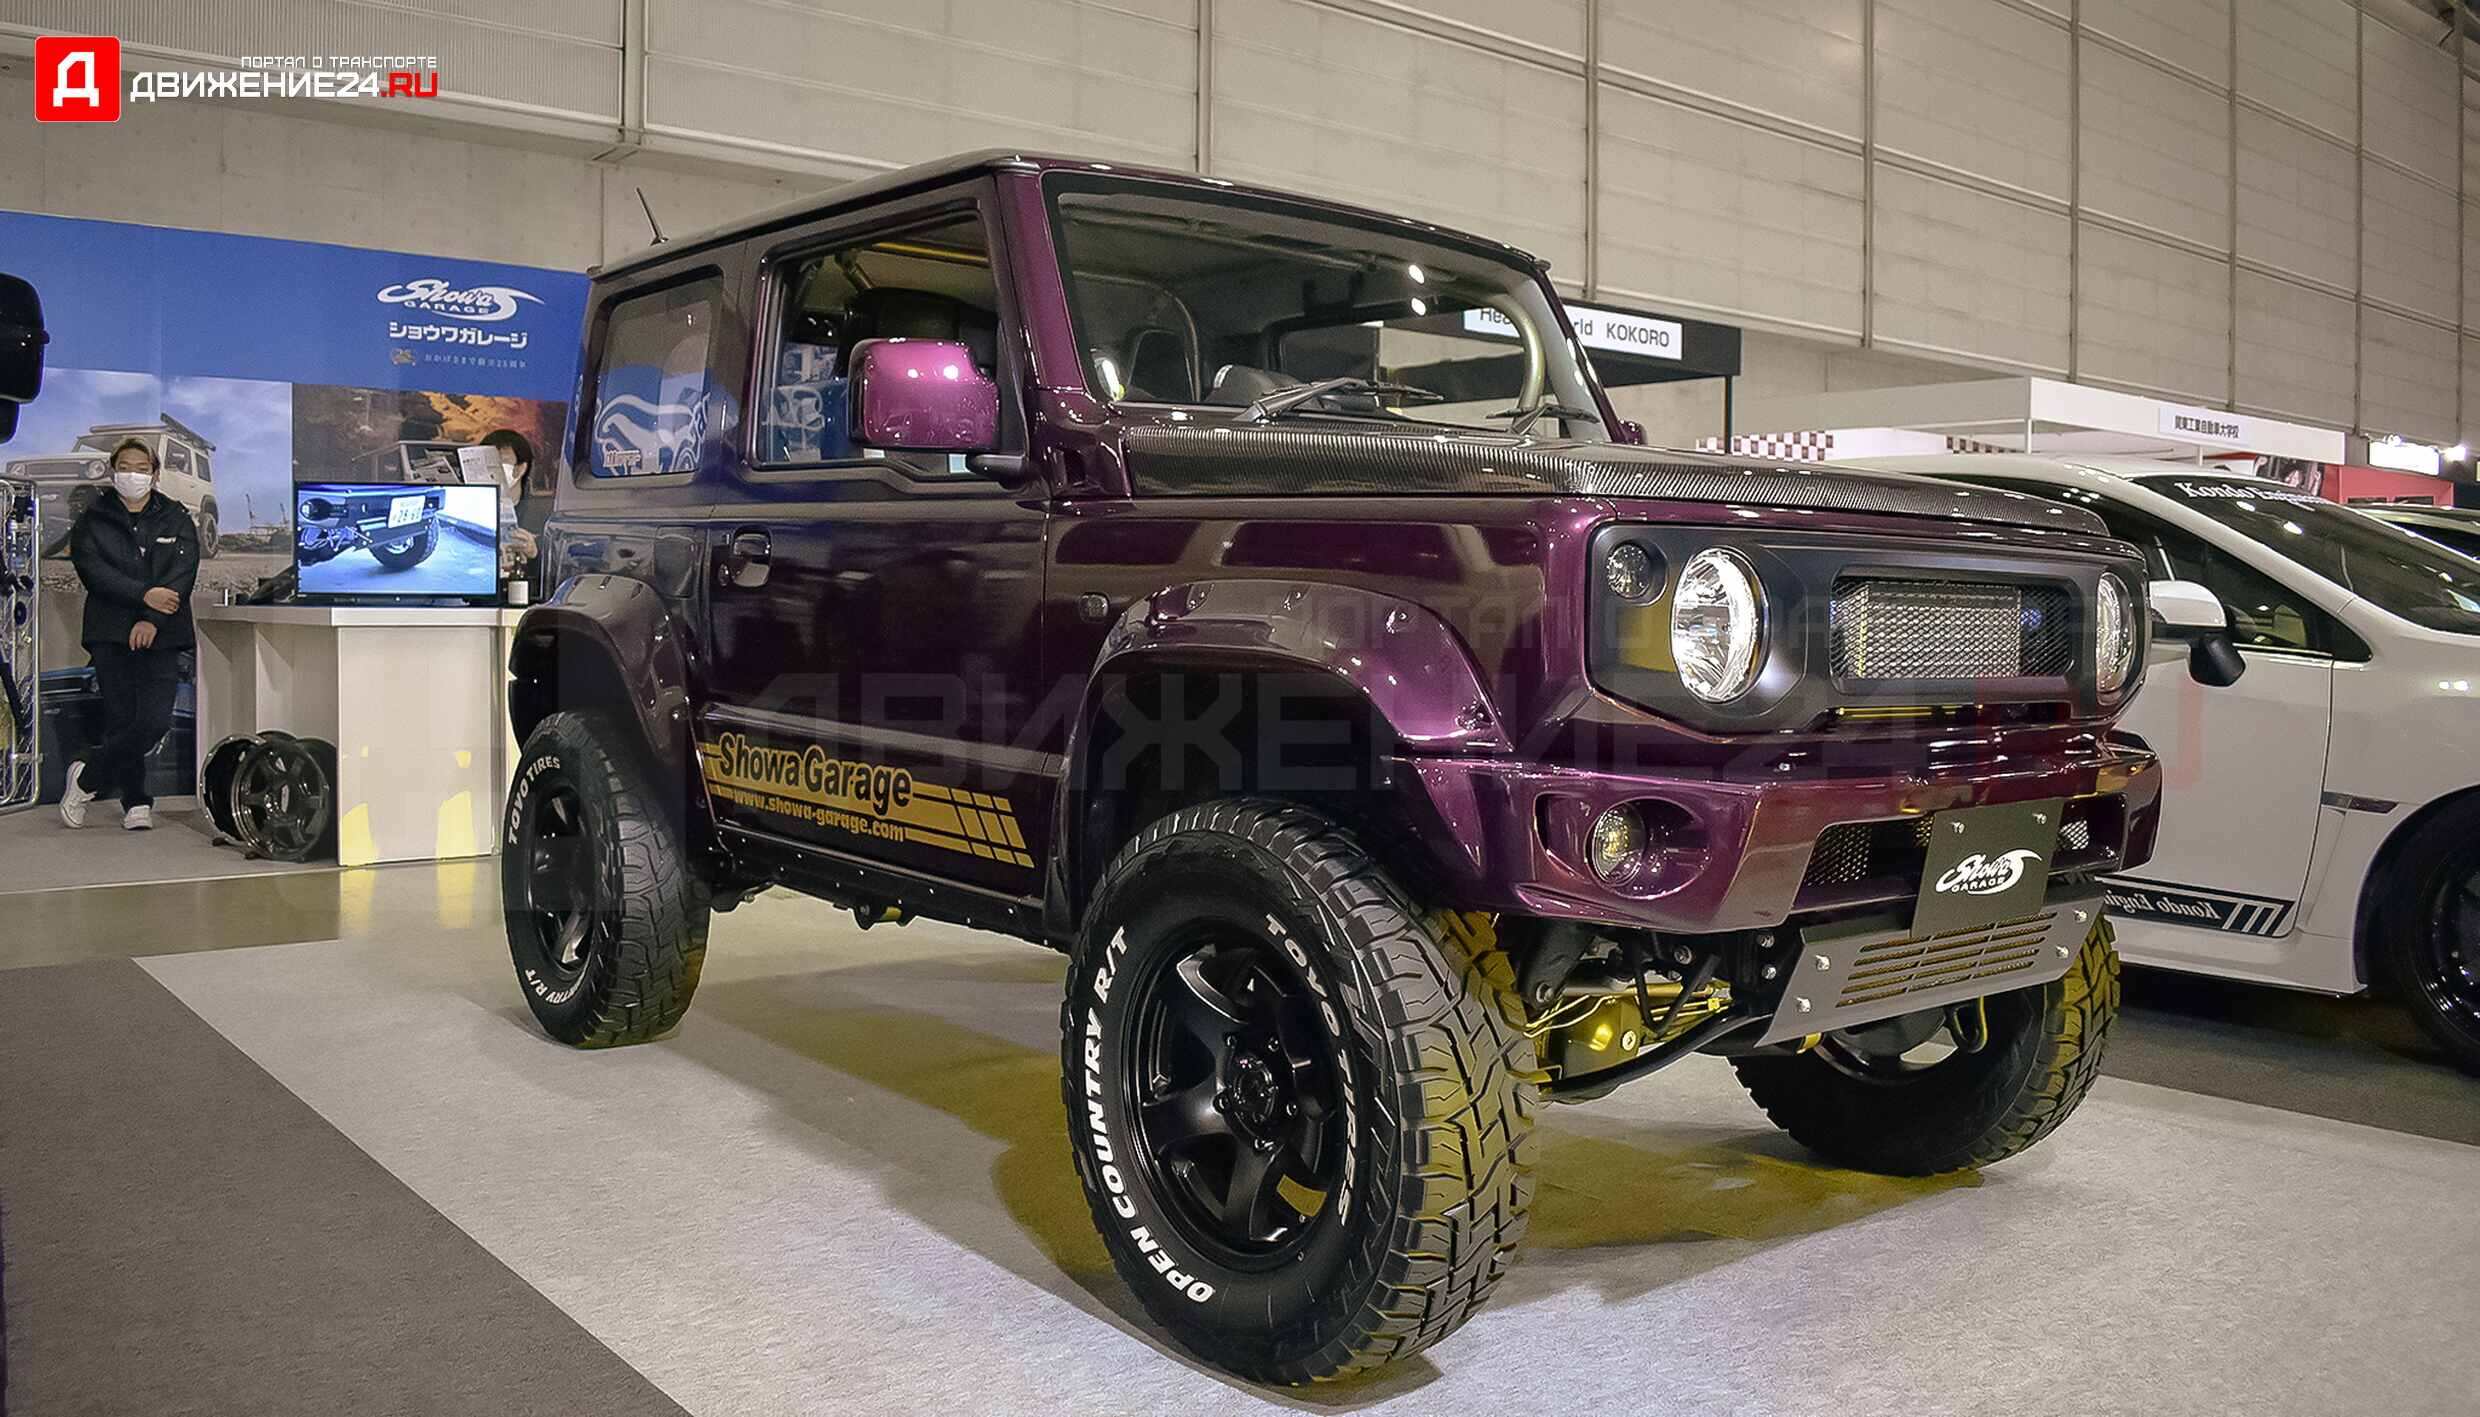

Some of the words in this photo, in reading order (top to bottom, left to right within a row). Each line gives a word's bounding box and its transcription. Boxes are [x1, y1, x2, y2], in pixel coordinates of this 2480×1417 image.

[377, 278, 516, 310] Showa
[404, 301, 491, 315] GARAGE
[389, 321, 529, 349] ショウワガレージ
[1606, 322, 1671, 348] KOKORO
[2174, 482, 2255, 499] Kondo
[718, 732, 801, 787] Showa
[803, 744, 913, 818] Garage
[508, 777, 529, 845] TOYO
[526, 755, 561, 782] TIRES
[734, 788, 905, 842] www.showa-garage.com
[1936, 851, 2026, 893] Showa
[1951, 876, 2006, 893] GARAGE
[1093, 925, 1129, 1004] R/T
[1266, 913, 1340, 1037] TOYO
[1337, 1048, 1357, 1227] TIRES
[1084, 1007, 1138, 1220] COUNTRY
[1129, 1225, 1216, 1303] OPEN
